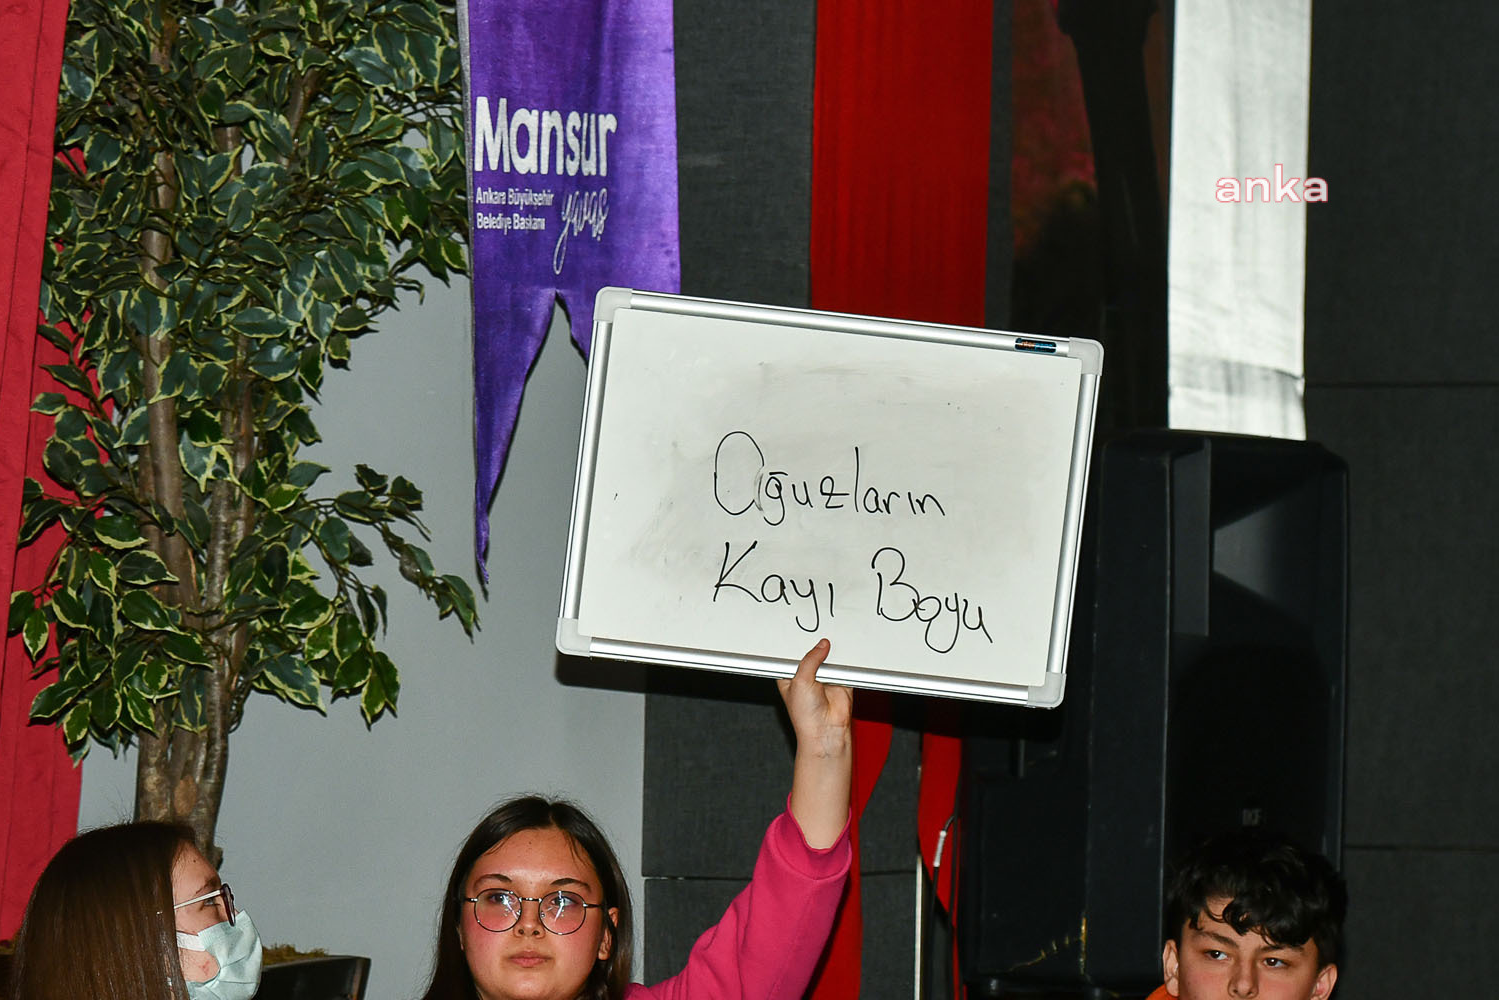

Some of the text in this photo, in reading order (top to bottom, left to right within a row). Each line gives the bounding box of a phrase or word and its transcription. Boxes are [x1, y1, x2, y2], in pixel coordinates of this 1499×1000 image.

[474, 96, 618, 177] Mansur
[475, 186, 507, 205] Ankara
[713, 430, 946, 526] Oğuzların
[712, 540, 836, 633] Kayı
